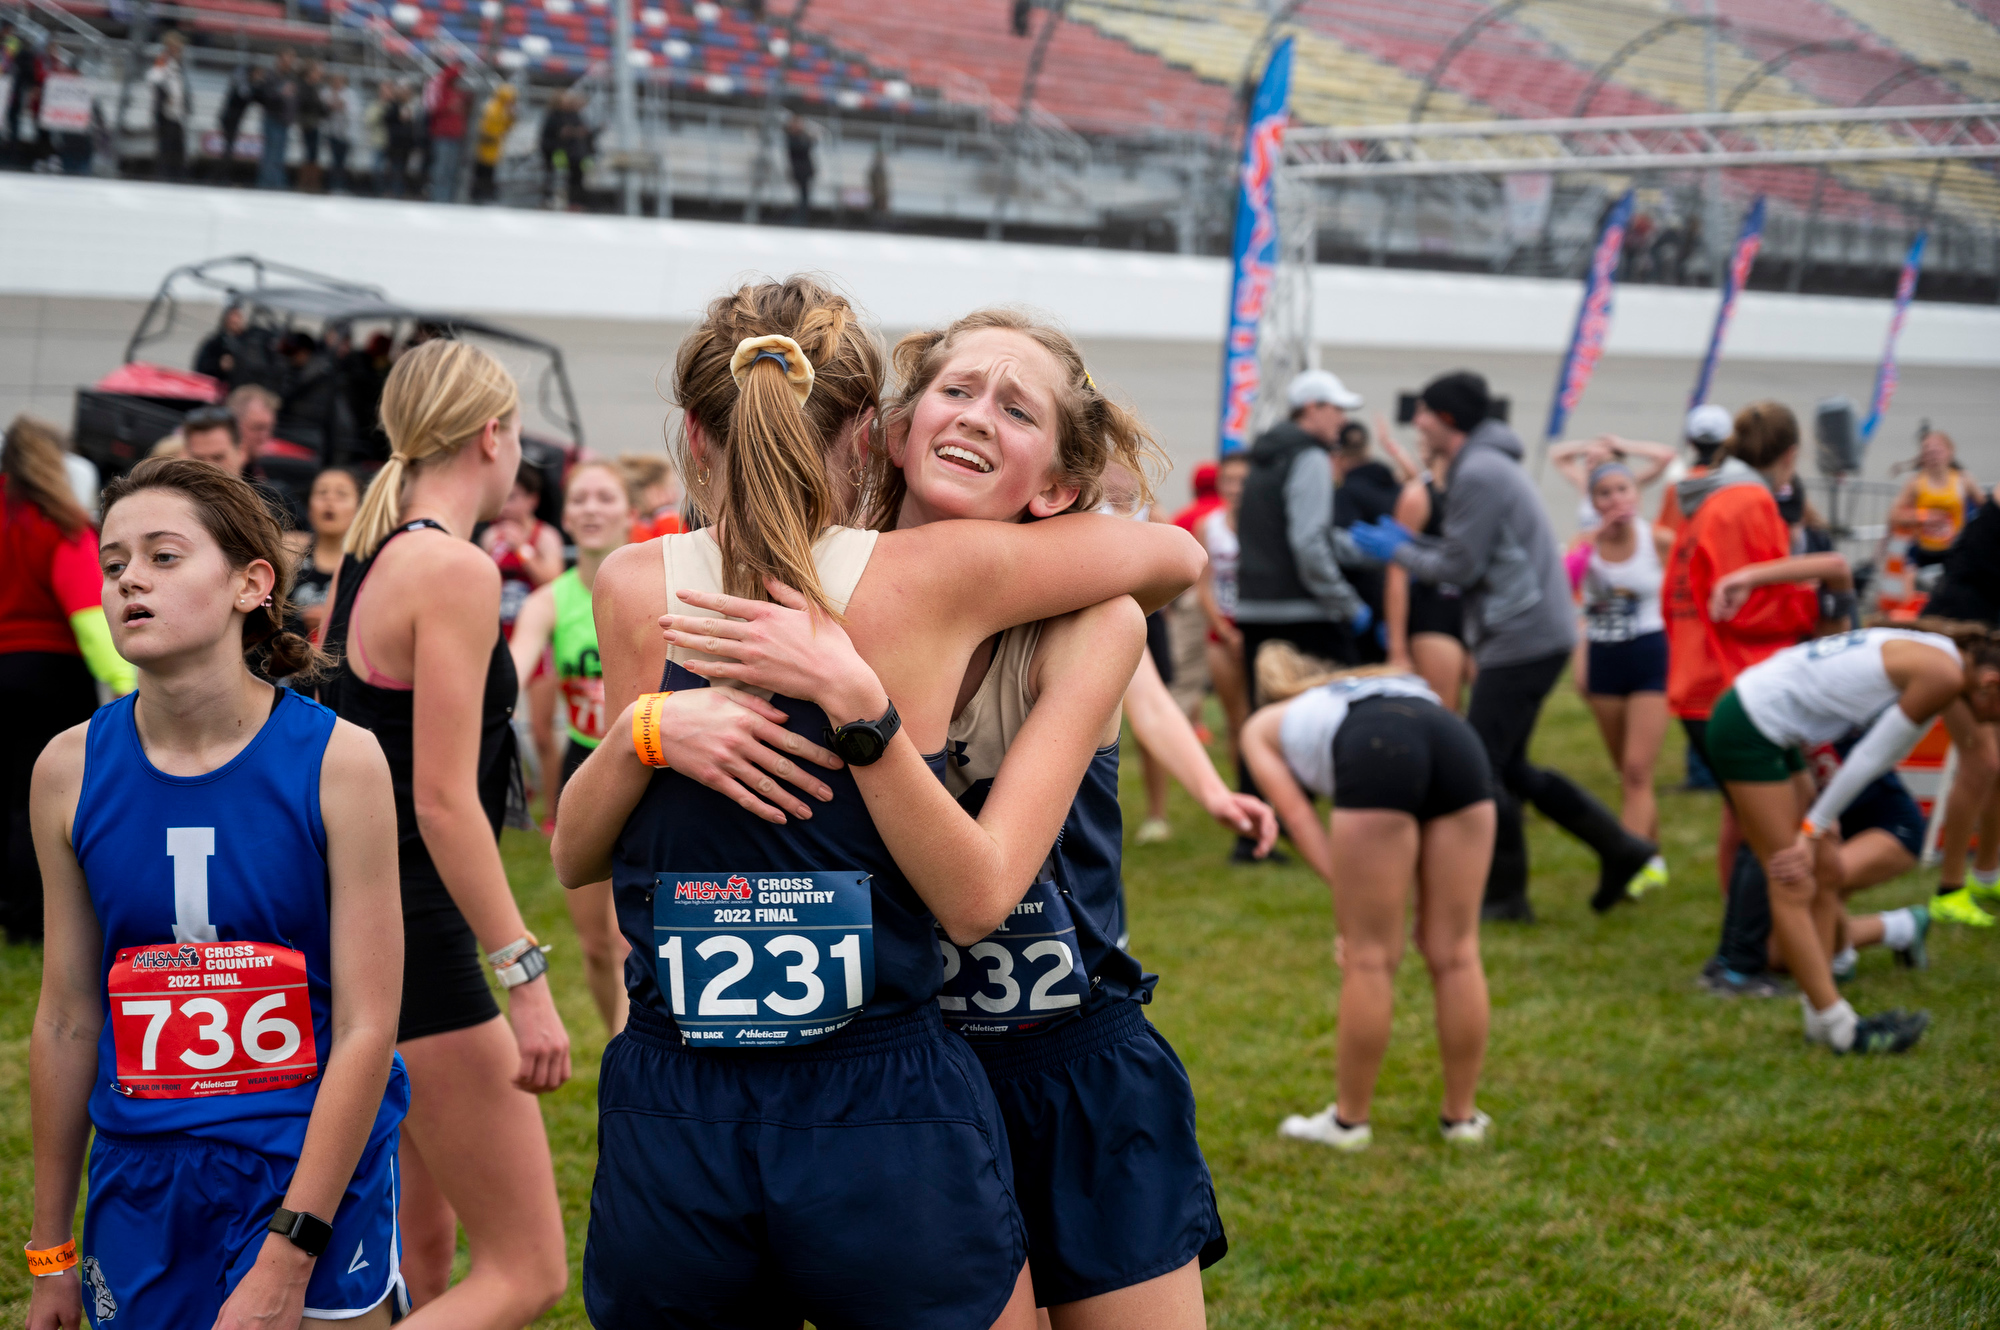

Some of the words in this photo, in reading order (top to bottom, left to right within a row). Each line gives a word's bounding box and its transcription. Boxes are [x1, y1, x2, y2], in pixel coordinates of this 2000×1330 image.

[166, 827, 219, 944] I
[674, 880, 742, 900] MHSAA
[757, 878, 814, 891] CROSS
[758, 891, 835, 904] COUNTRY
[713, 908, 751, 923] 2022
[755, 908, 798, 922] FINAL
[132, 949, 194, 968] MHSAA
[204, 945, 255, 959] CROSS
[205, 956, 275, 970] COUNTRY
[167, 975, 201, 988] 2022
[203, 973, 242, 987] FINAL
[658, 934, 863, 1016] 1231
[936, 940, 1081, 1013] 232
[121, 992, 301, 1070] 736
[691, 1031, 702, 1039] ON
[702, 1031, 725, 1039] BACK
[800, 1028, 824, 1037] WEAR
[824, 1025, 836, 1033] ON
[247, 1077, 268, 1085] WEAR
[280, 1073, 303, 1082] FRONT
